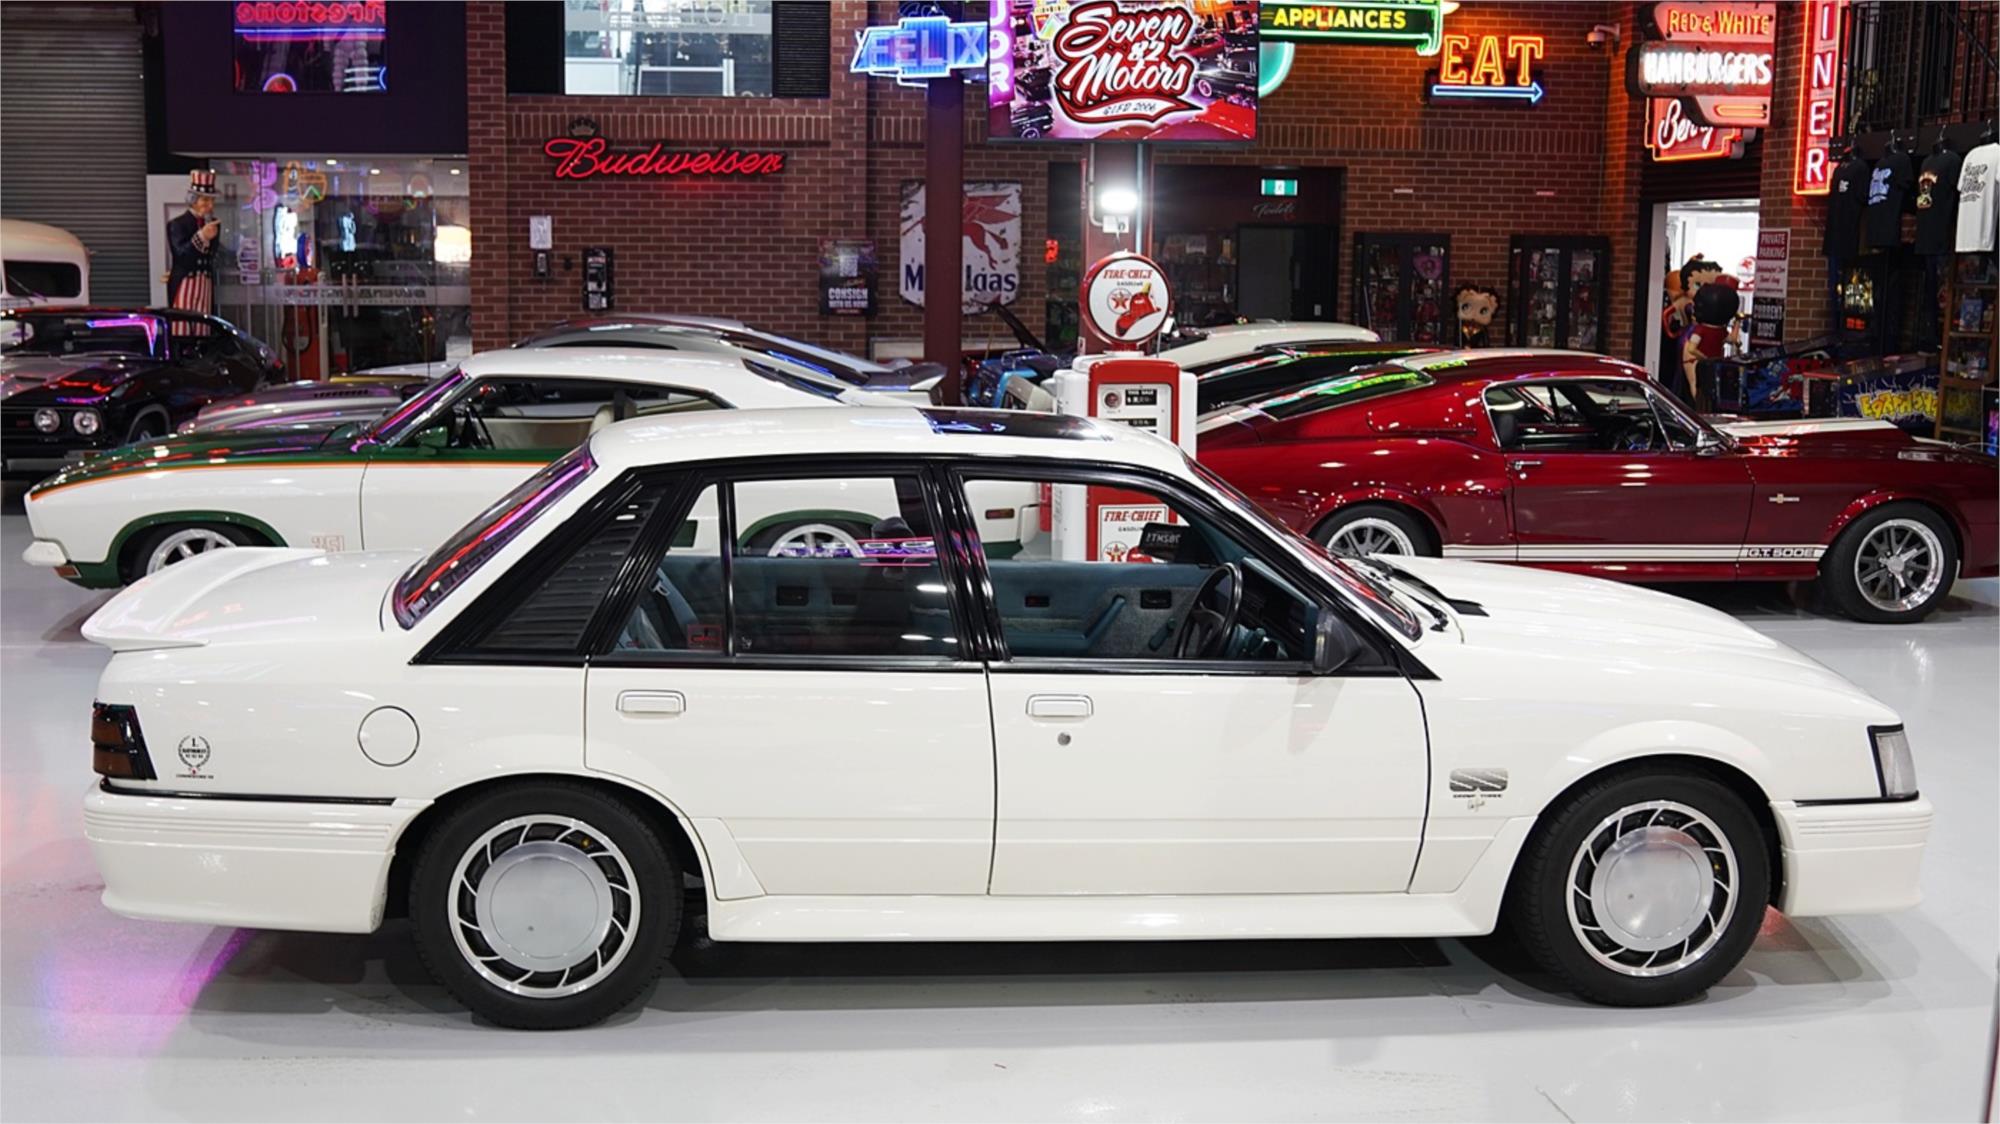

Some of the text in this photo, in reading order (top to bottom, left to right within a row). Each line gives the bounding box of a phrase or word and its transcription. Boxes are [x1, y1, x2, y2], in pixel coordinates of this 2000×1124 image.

[1060, 5, 1186, 58] Seven
[1273, 8, 1407, 29] APPLIANCES
[1669, 10, 1770, 35] RED & WHITE
[867, 27, 981, 67] FELIX
[1127, 41, 1167, 62] 82
[1440, 35, 1544, 86] EAT
[1063, 52, 1188, 102] Motors
[1643, 51, 1773, 86] HAMBURGERS
[544, 138, 784, 179] Budweiser
